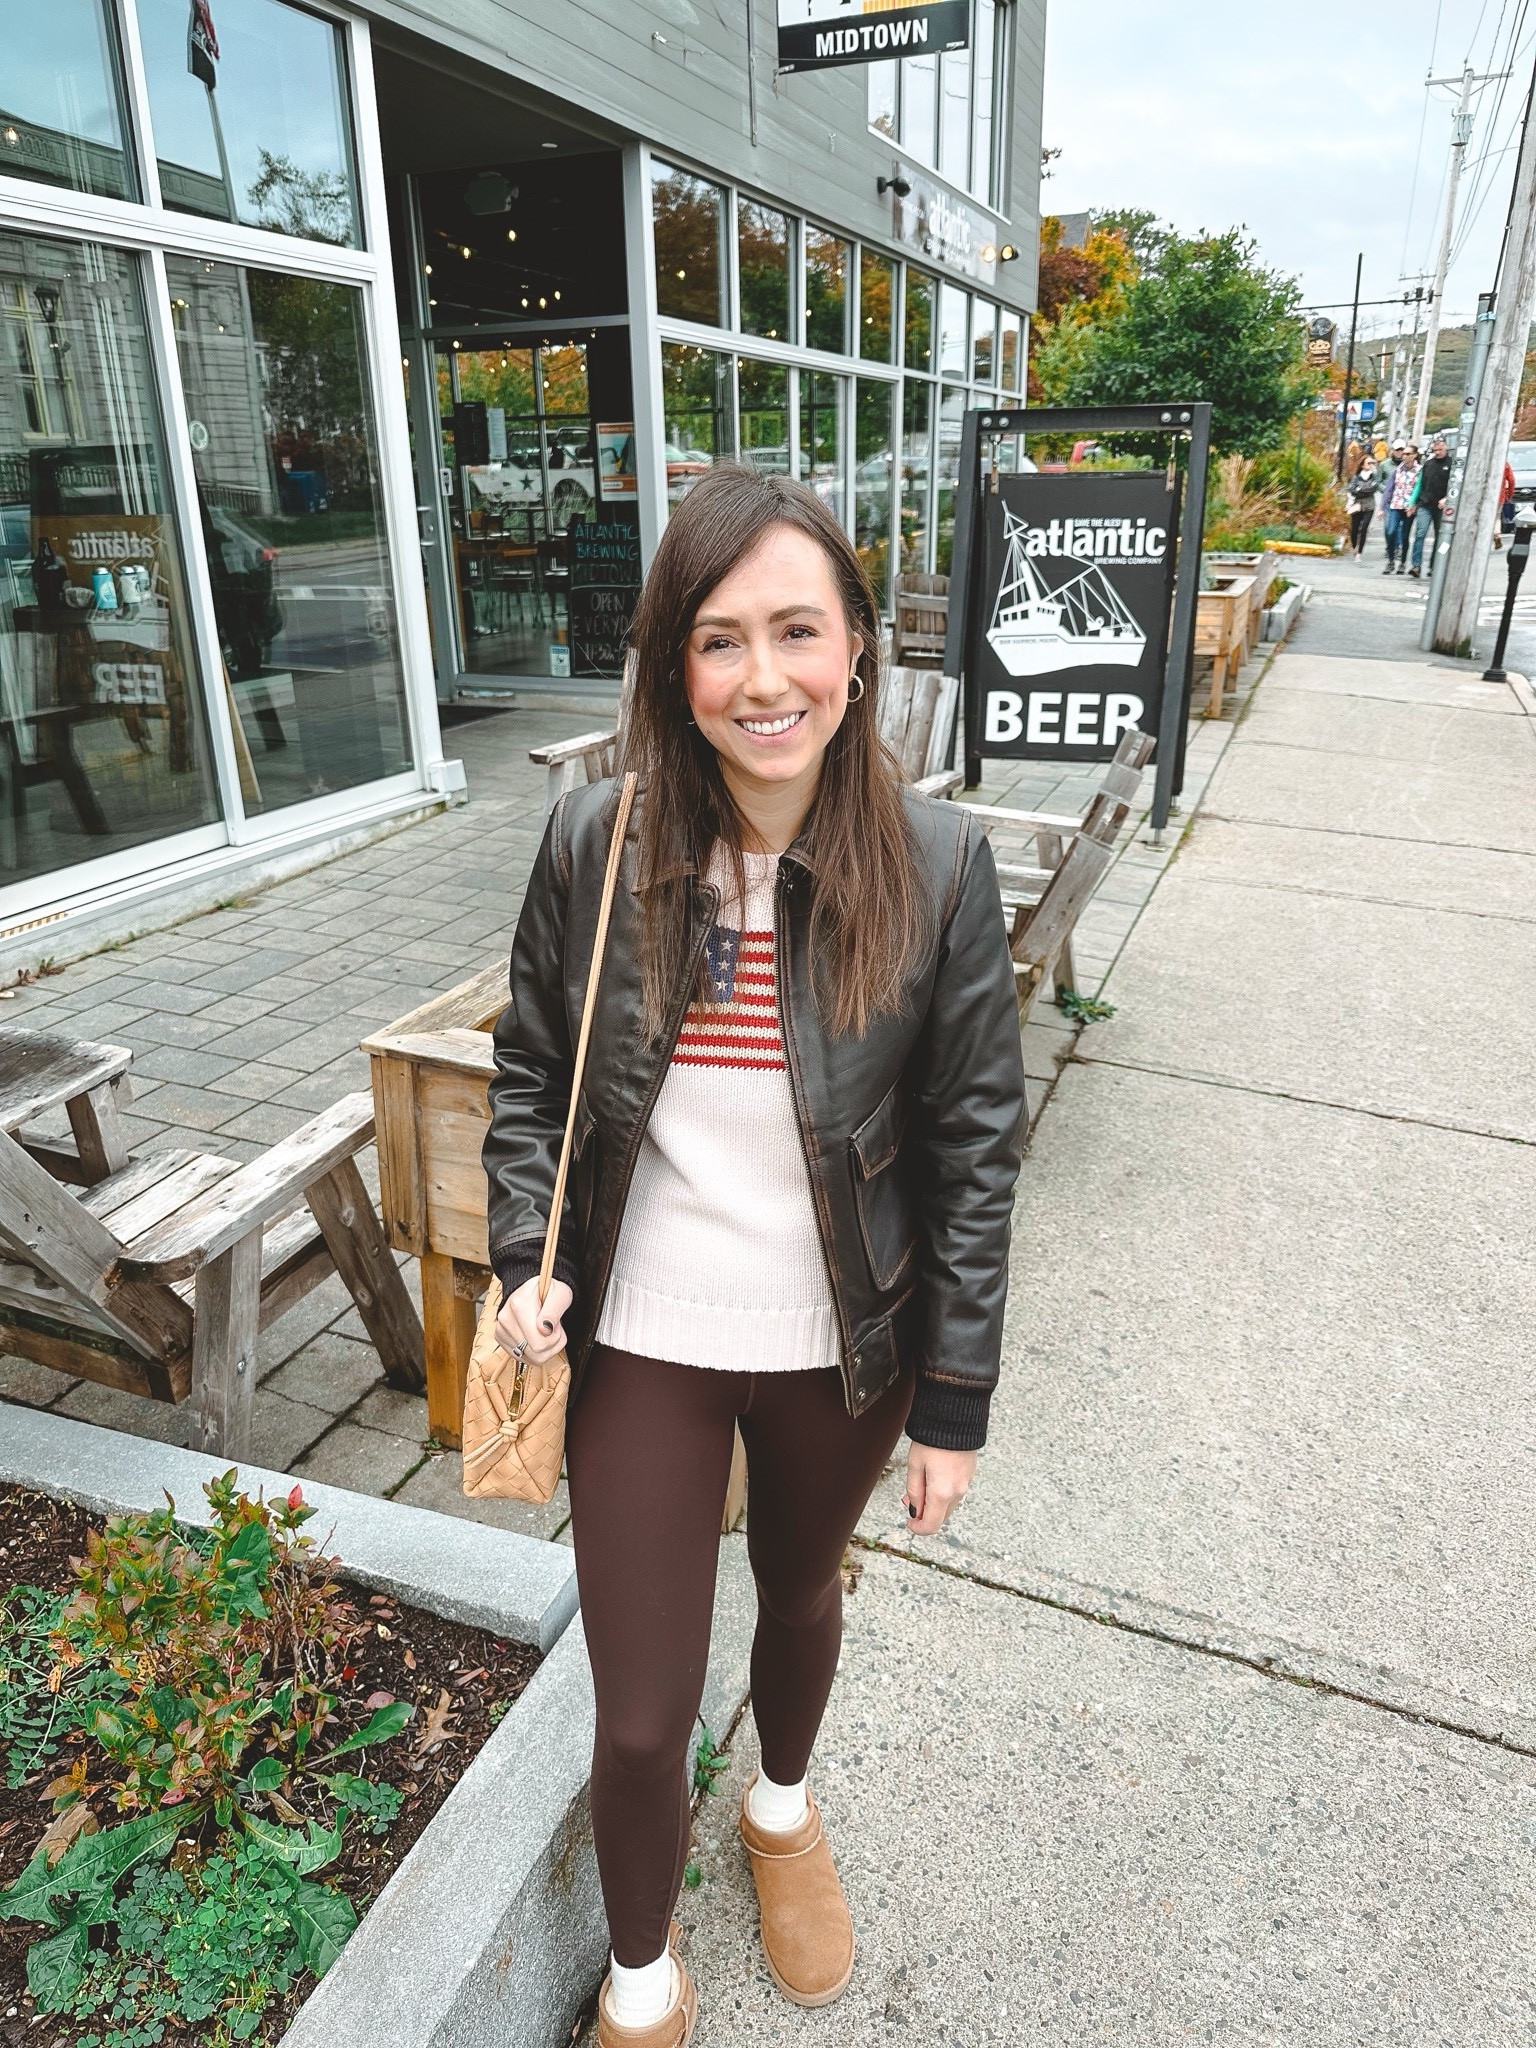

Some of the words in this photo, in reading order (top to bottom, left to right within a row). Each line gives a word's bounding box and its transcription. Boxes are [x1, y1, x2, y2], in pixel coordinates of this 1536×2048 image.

[815, 17, 928, 57] MIDTOWN
[575, 522, 640, 540] ATLANTIC
[1025, 517, 1167, 557] atlantic
[576, 543, 639, 560] BREWING
[1093, 557, 1127, 565] BREWING
[1128, 556, 1163, 565] COMPANY
[591, 592, 625, 612] OPEN
[573, 613, 629, 637] EVERYD
[985, 690, 1145, 745] BEER
